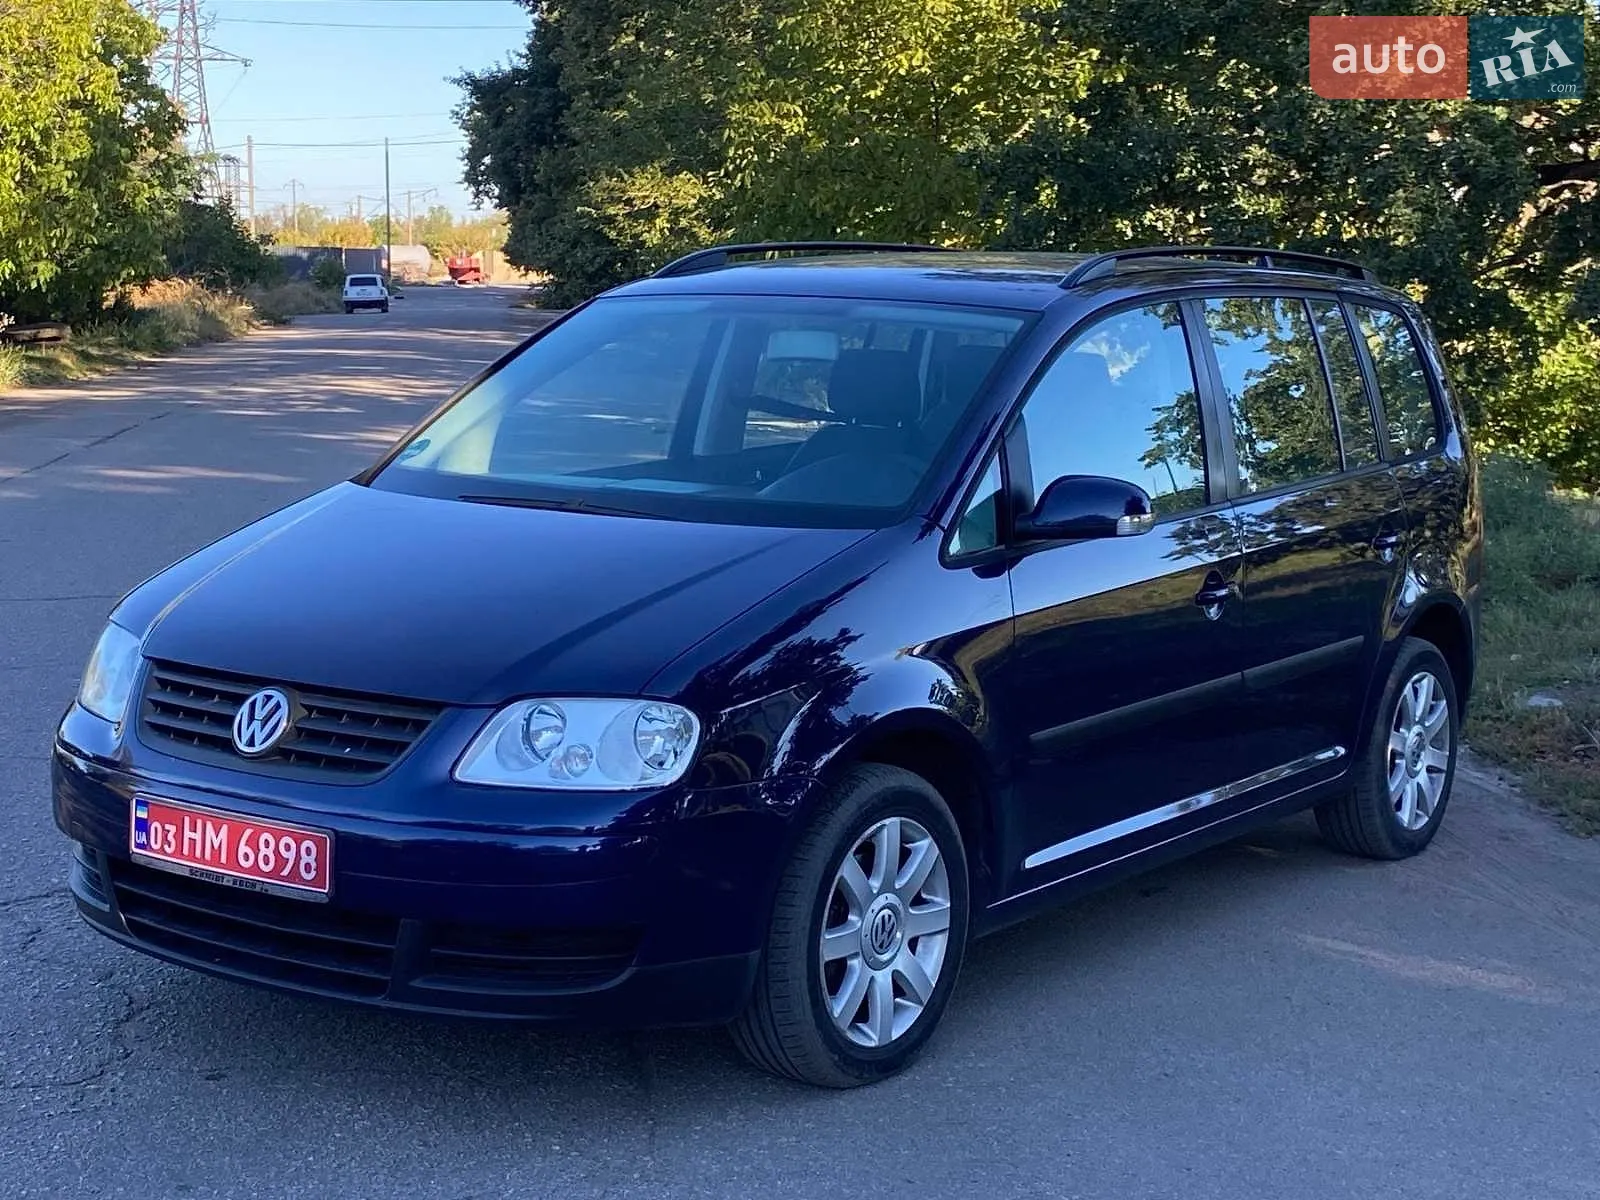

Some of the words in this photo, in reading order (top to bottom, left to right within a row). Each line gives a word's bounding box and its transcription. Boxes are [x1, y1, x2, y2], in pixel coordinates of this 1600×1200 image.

[135, 830, 147, 845] UA
[150, 821, 177, 854] 03
[183, 815, 228, 865] HM
[237, 828, 318, 881] 6898
